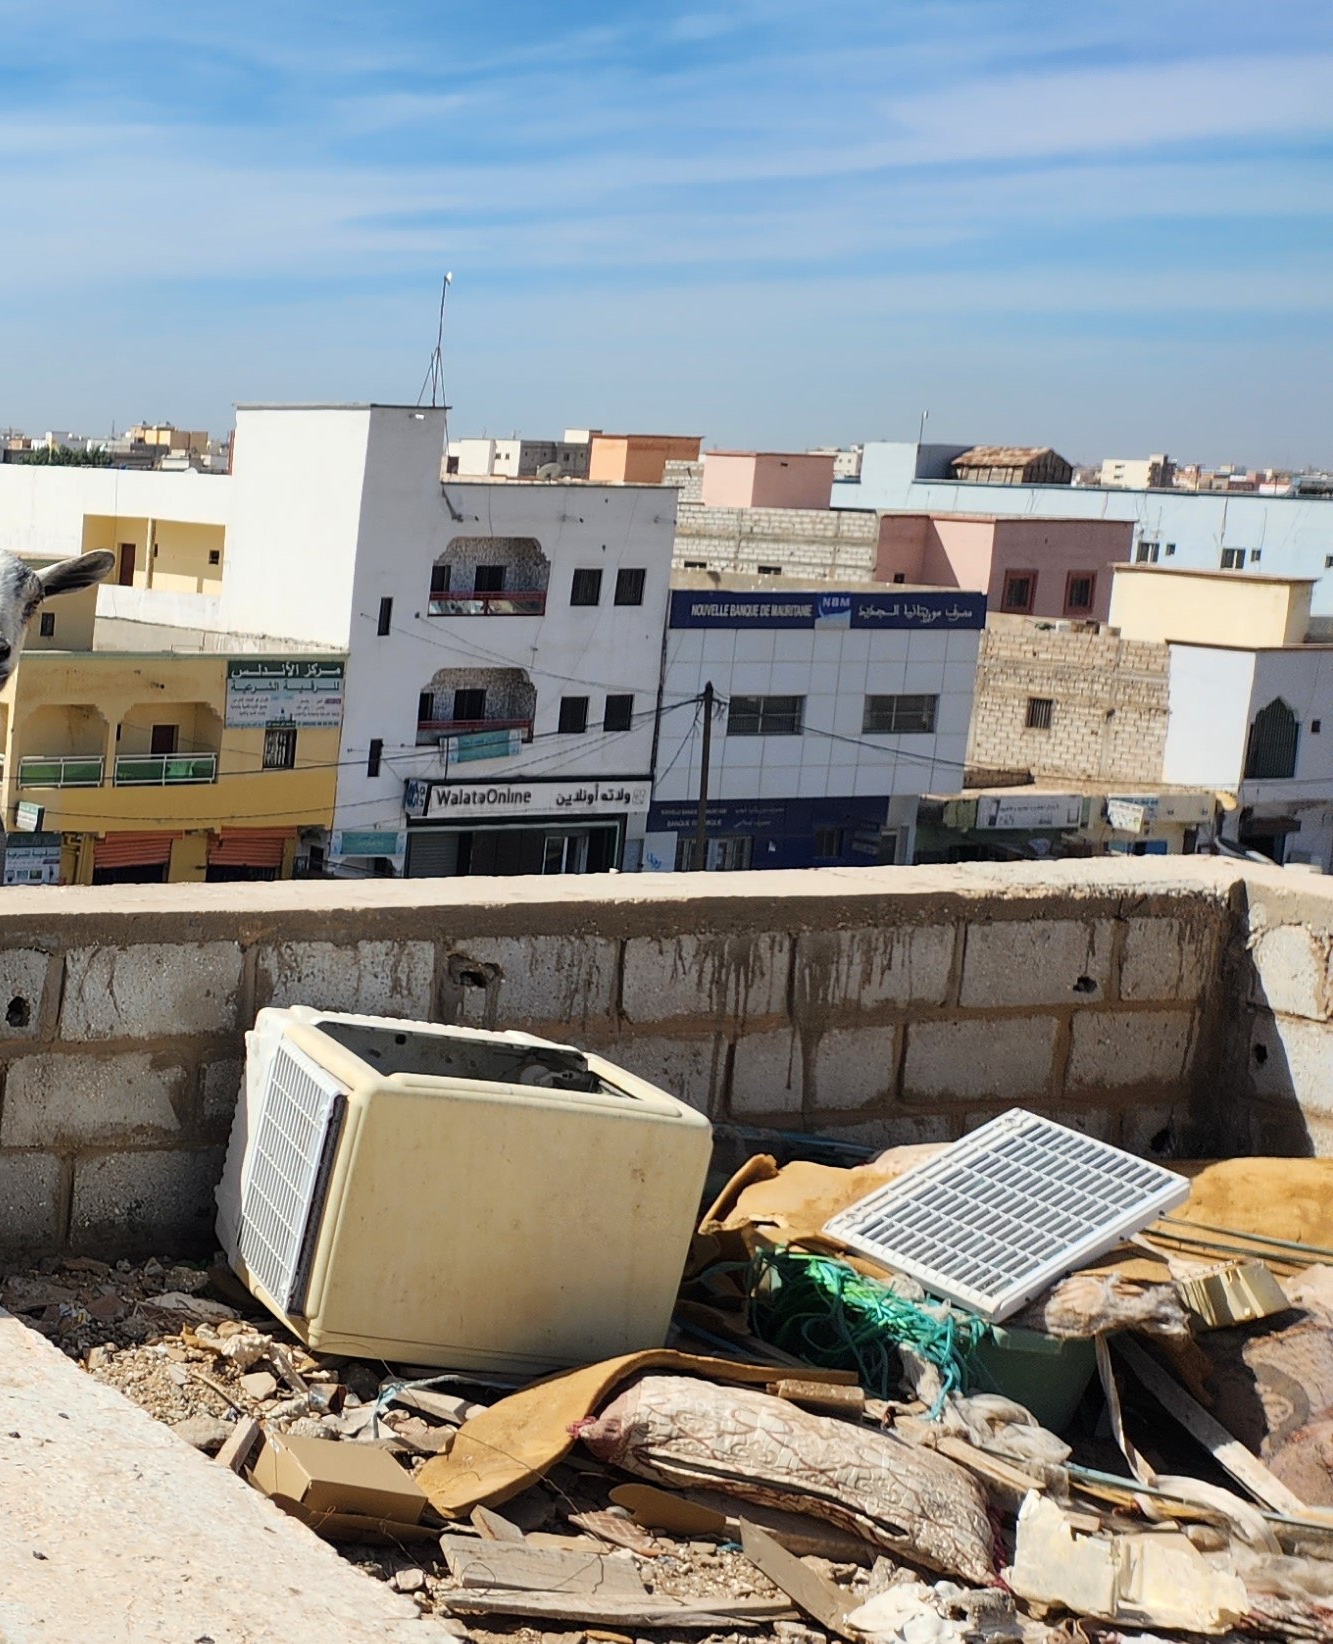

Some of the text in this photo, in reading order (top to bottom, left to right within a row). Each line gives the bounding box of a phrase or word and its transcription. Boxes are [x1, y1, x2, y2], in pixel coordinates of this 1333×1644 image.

[822, 597, 850, 608] NBM
[730, 604, 759, 617] BANQUE
[760, 604, 770, 617] DE
[231, 661, 341, 678] مركز الأندلس
[436, 787, 532, 806] WalataOnline
